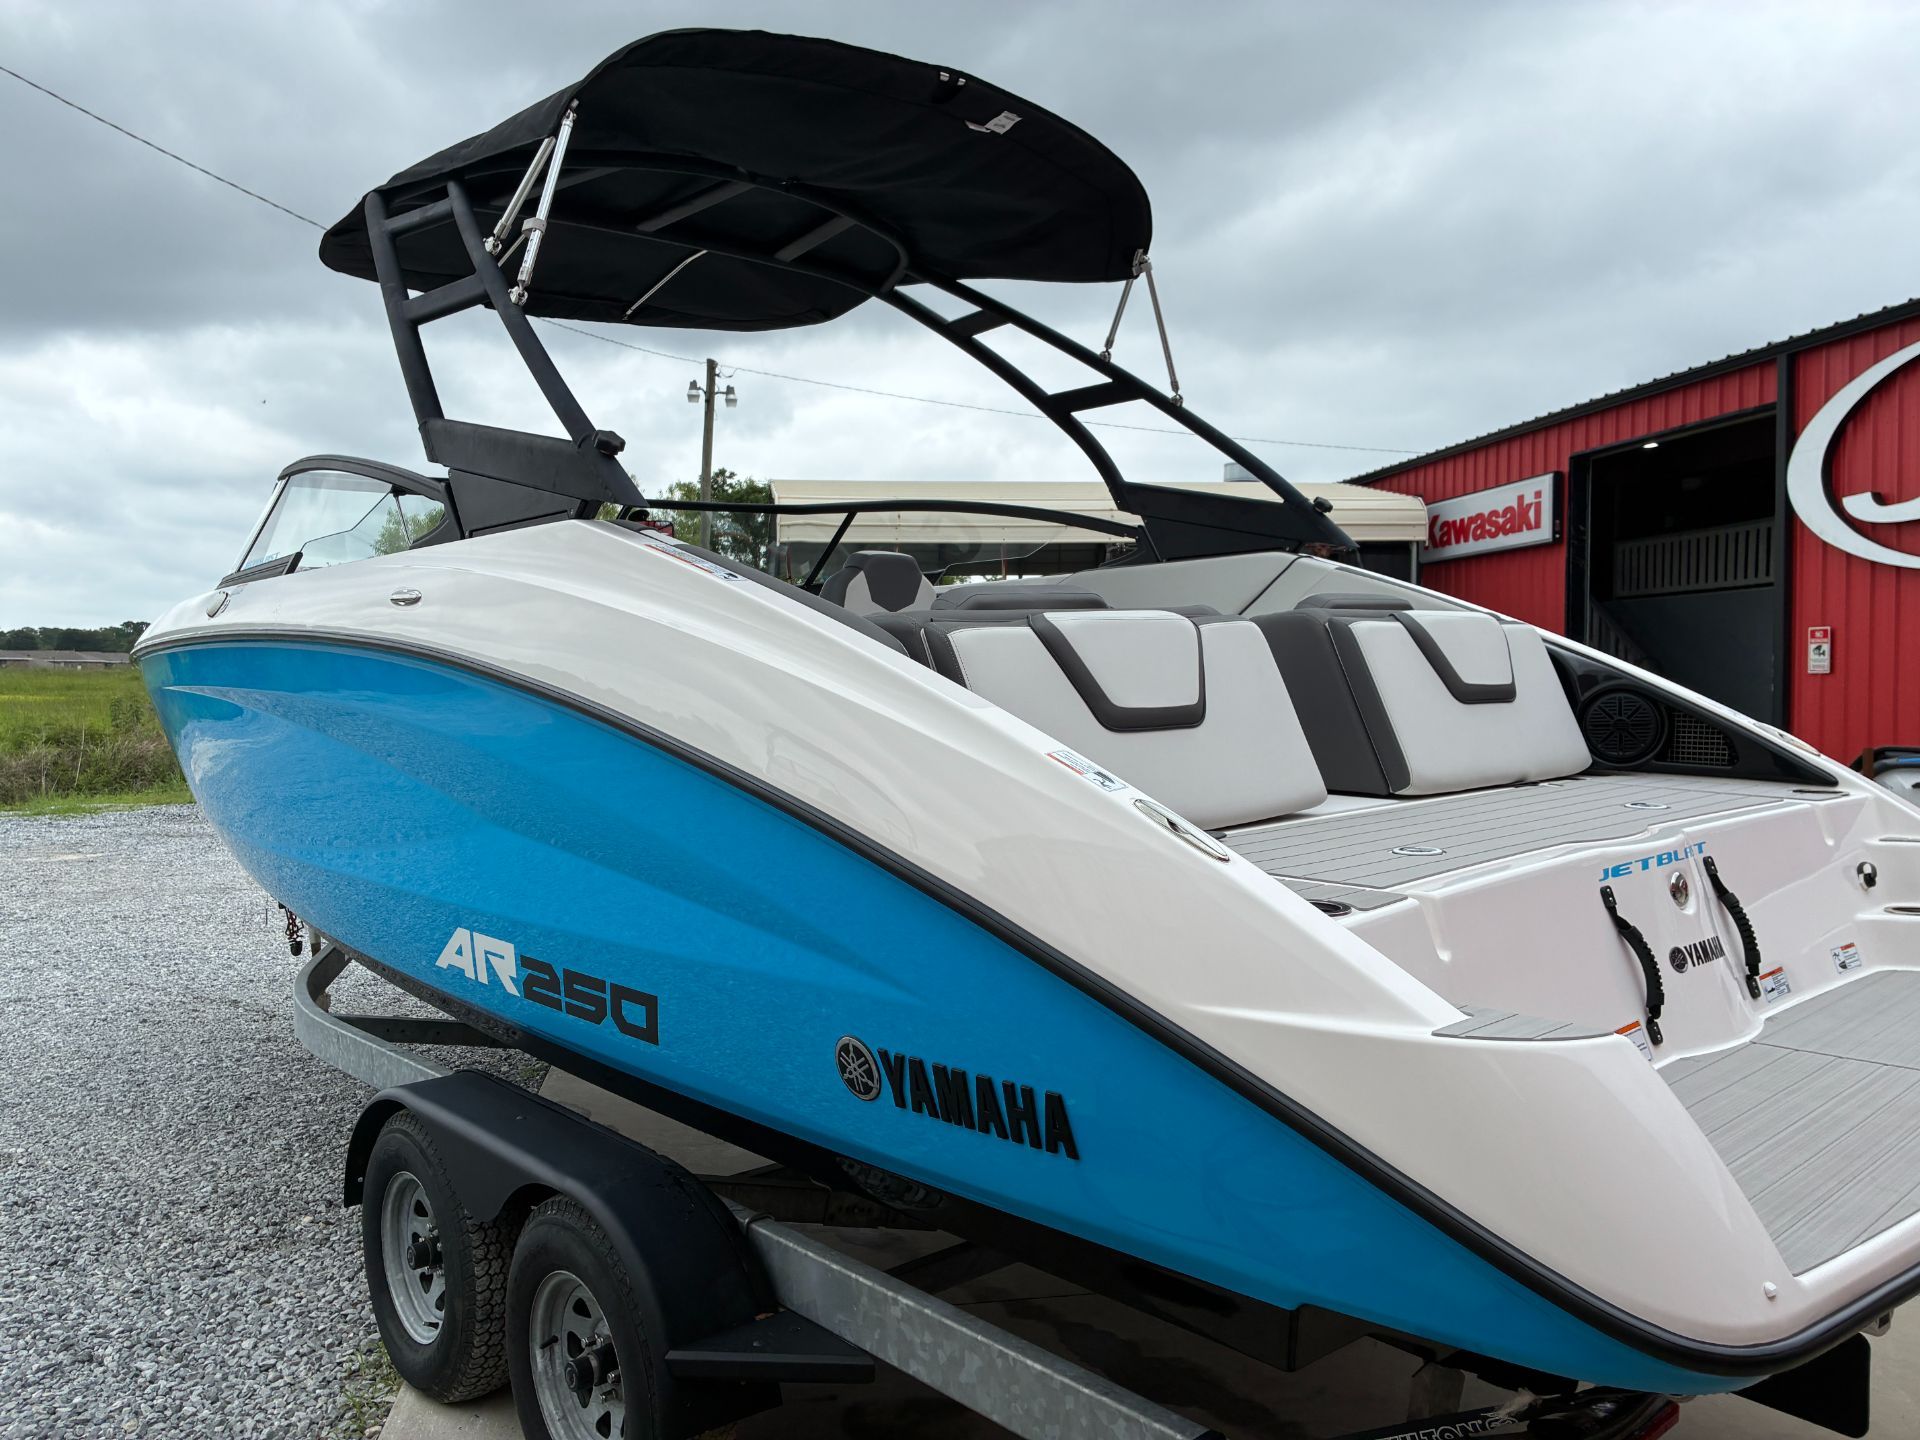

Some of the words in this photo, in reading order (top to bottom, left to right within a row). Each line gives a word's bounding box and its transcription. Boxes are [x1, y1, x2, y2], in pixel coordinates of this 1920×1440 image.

[1426, 489, 1543, 549] Kawasaki
[1683, 935, 1726, 967] YAMAHA
[877, 1048, 1080, 1160] YAMAHA
